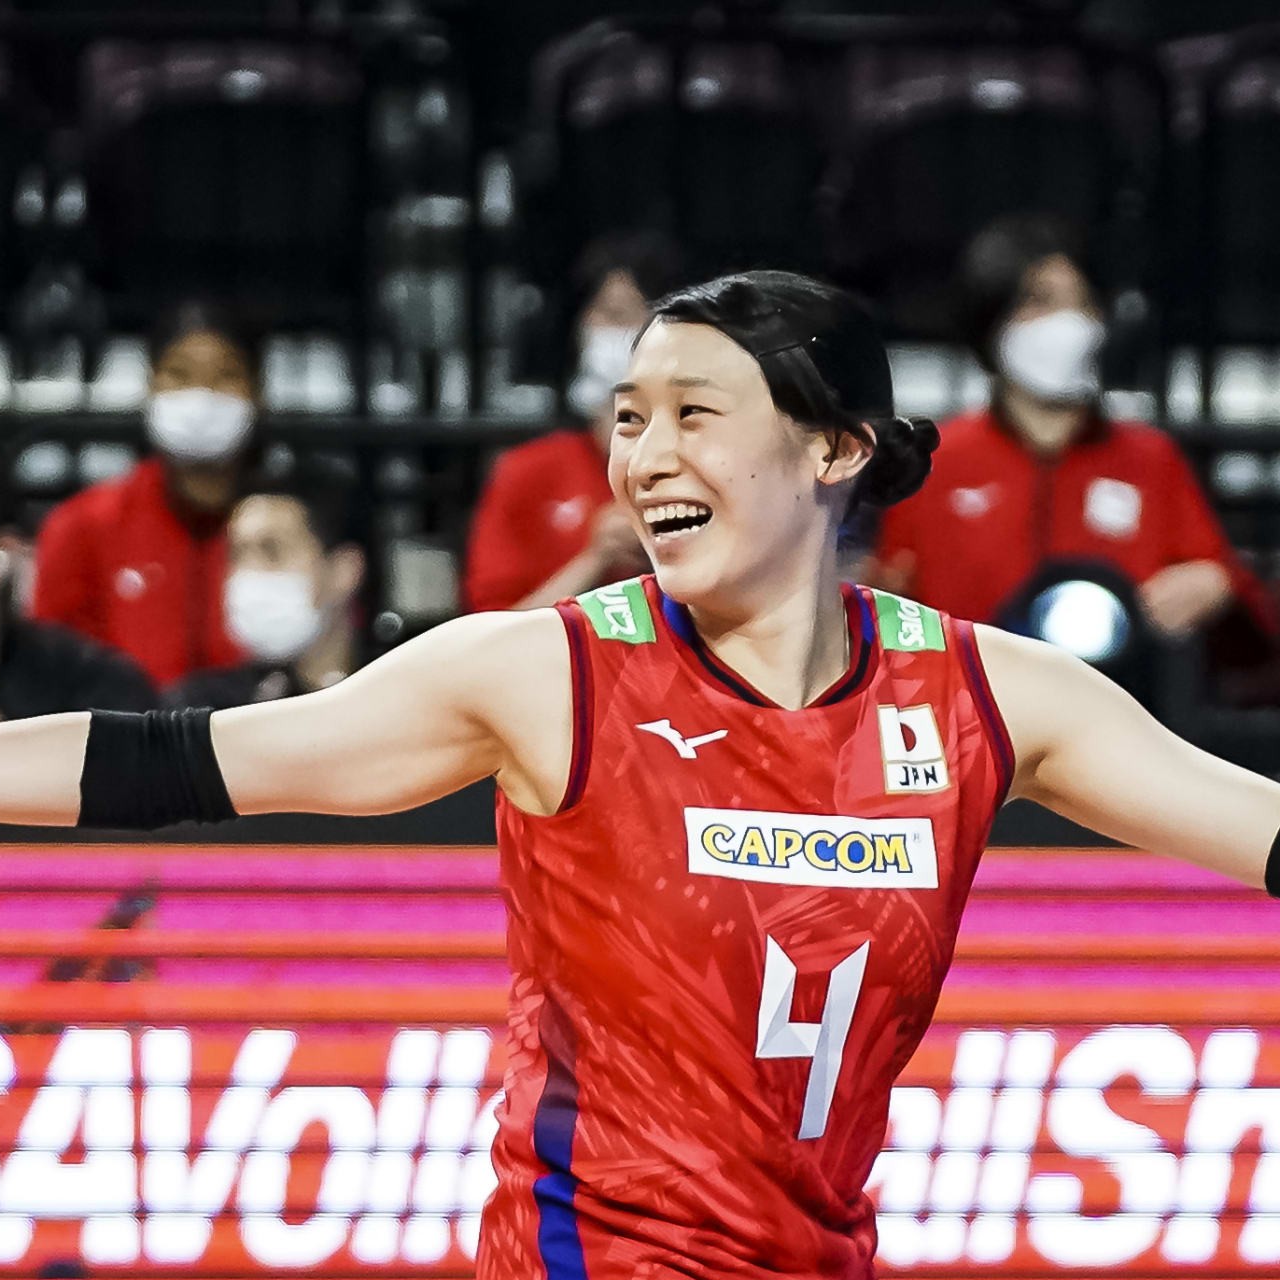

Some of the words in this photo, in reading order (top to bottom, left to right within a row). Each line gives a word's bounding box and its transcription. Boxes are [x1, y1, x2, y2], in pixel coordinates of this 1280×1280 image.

[899, 765, 938, 786] JPN
[700, 823, 913, 873] CAPCOM
[755, 934, 870, 1139] 4
